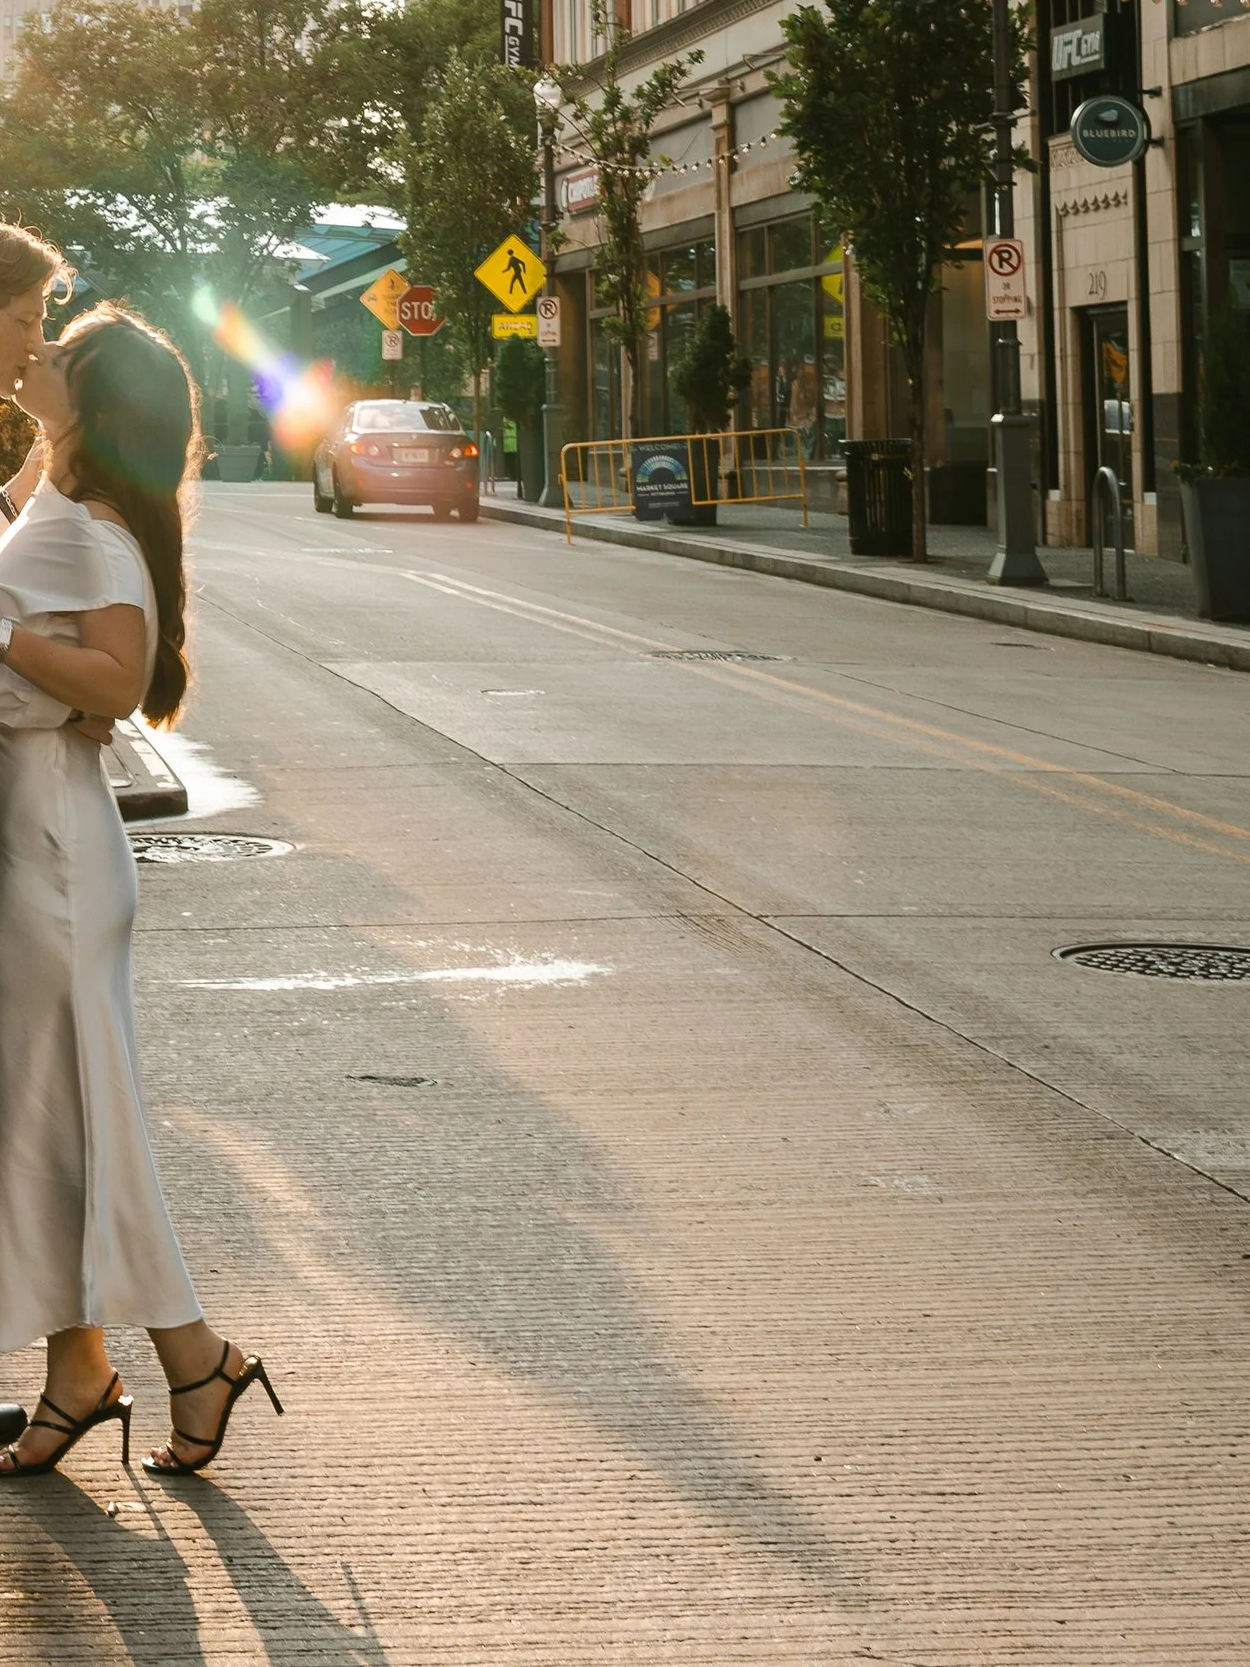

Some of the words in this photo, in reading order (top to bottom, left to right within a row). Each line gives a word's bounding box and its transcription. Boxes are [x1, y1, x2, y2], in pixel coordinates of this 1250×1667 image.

[1052, 29, 1082, 71] UFC
[1081, 31, 1100, 56] GYM
[1082, 129, 1137, 138] BLUEBIRD
[1088, 270, 1107, 300] 219
[401, 301, 437, 321] STO
[498, 321, 533, 332] AHEAD
[663, 482, 689, 490] SQUARE
